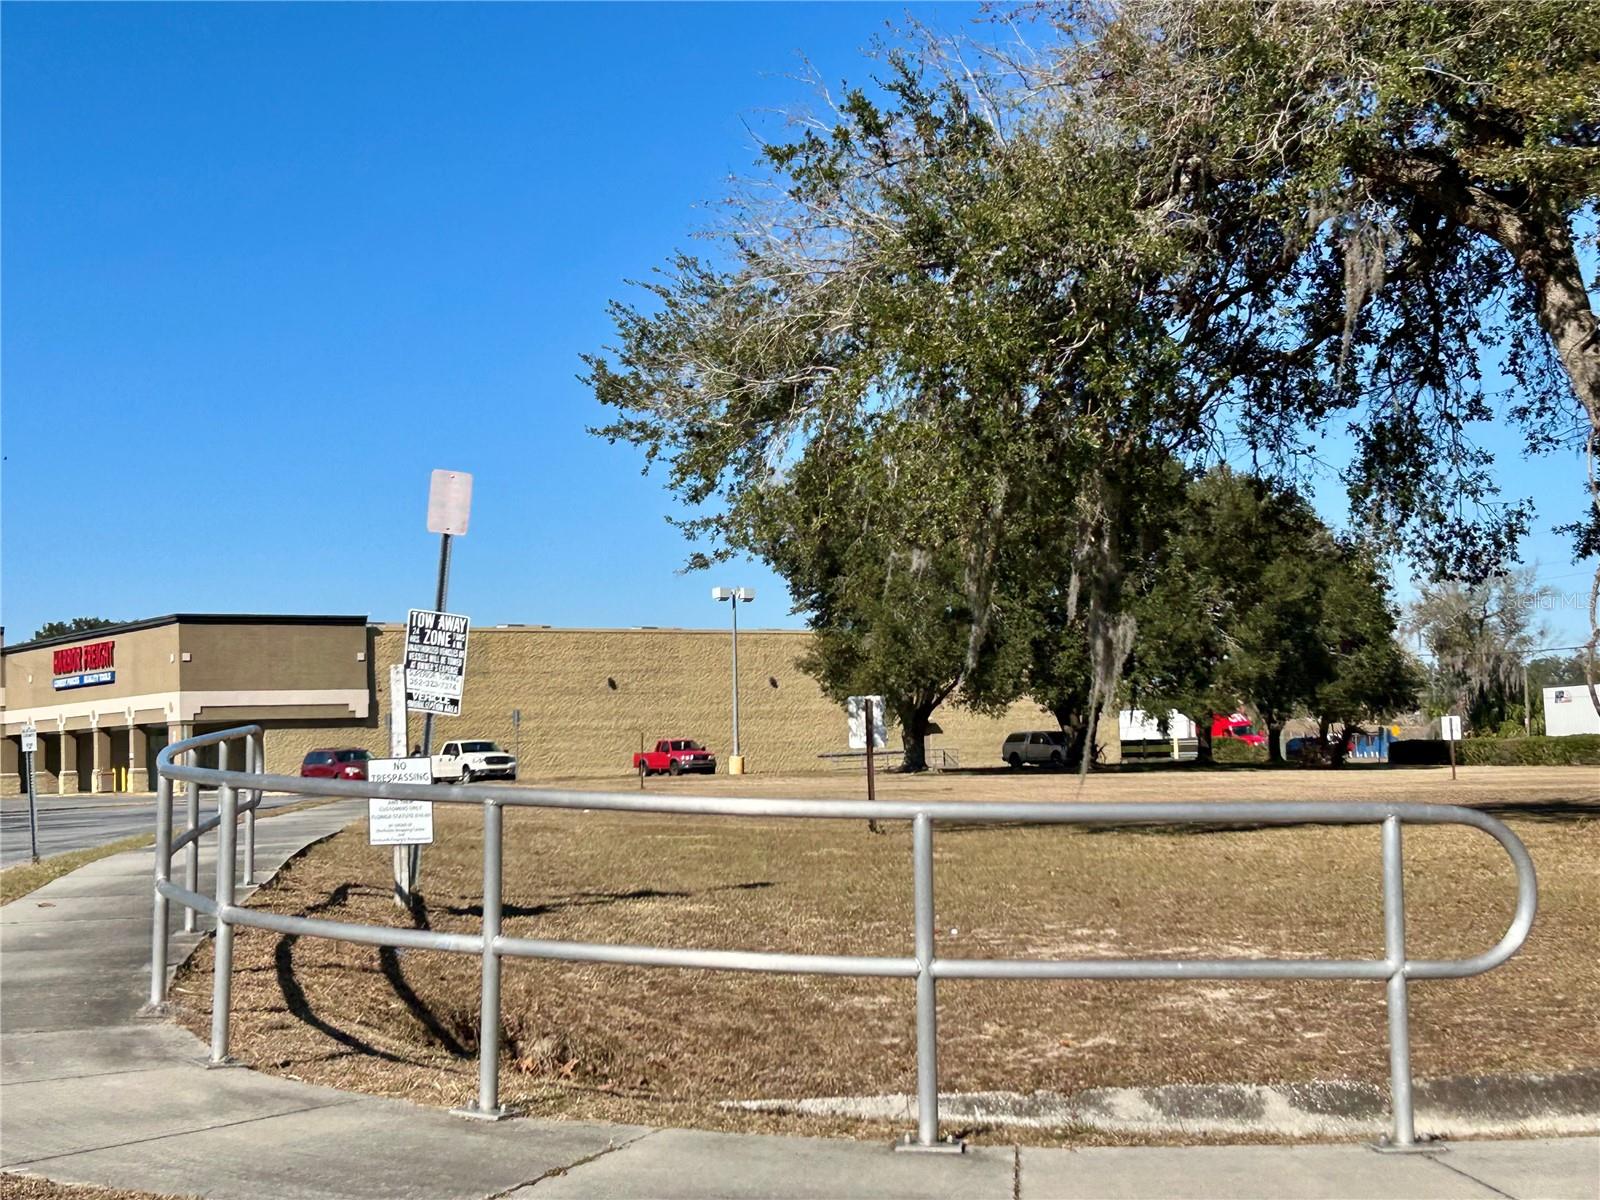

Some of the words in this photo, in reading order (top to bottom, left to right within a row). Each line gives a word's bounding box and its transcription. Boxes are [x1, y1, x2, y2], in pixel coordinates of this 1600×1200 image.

[412, 611, 435, 629] TOW
[437, 615, 467, 633] AWAY
[423, 629, 451, 648] ZONE
[83, 641, 115, 672] FREIGHT
[393, 761, 407, 770] NO
[371, 772, 430, 783] TRESPASSING
